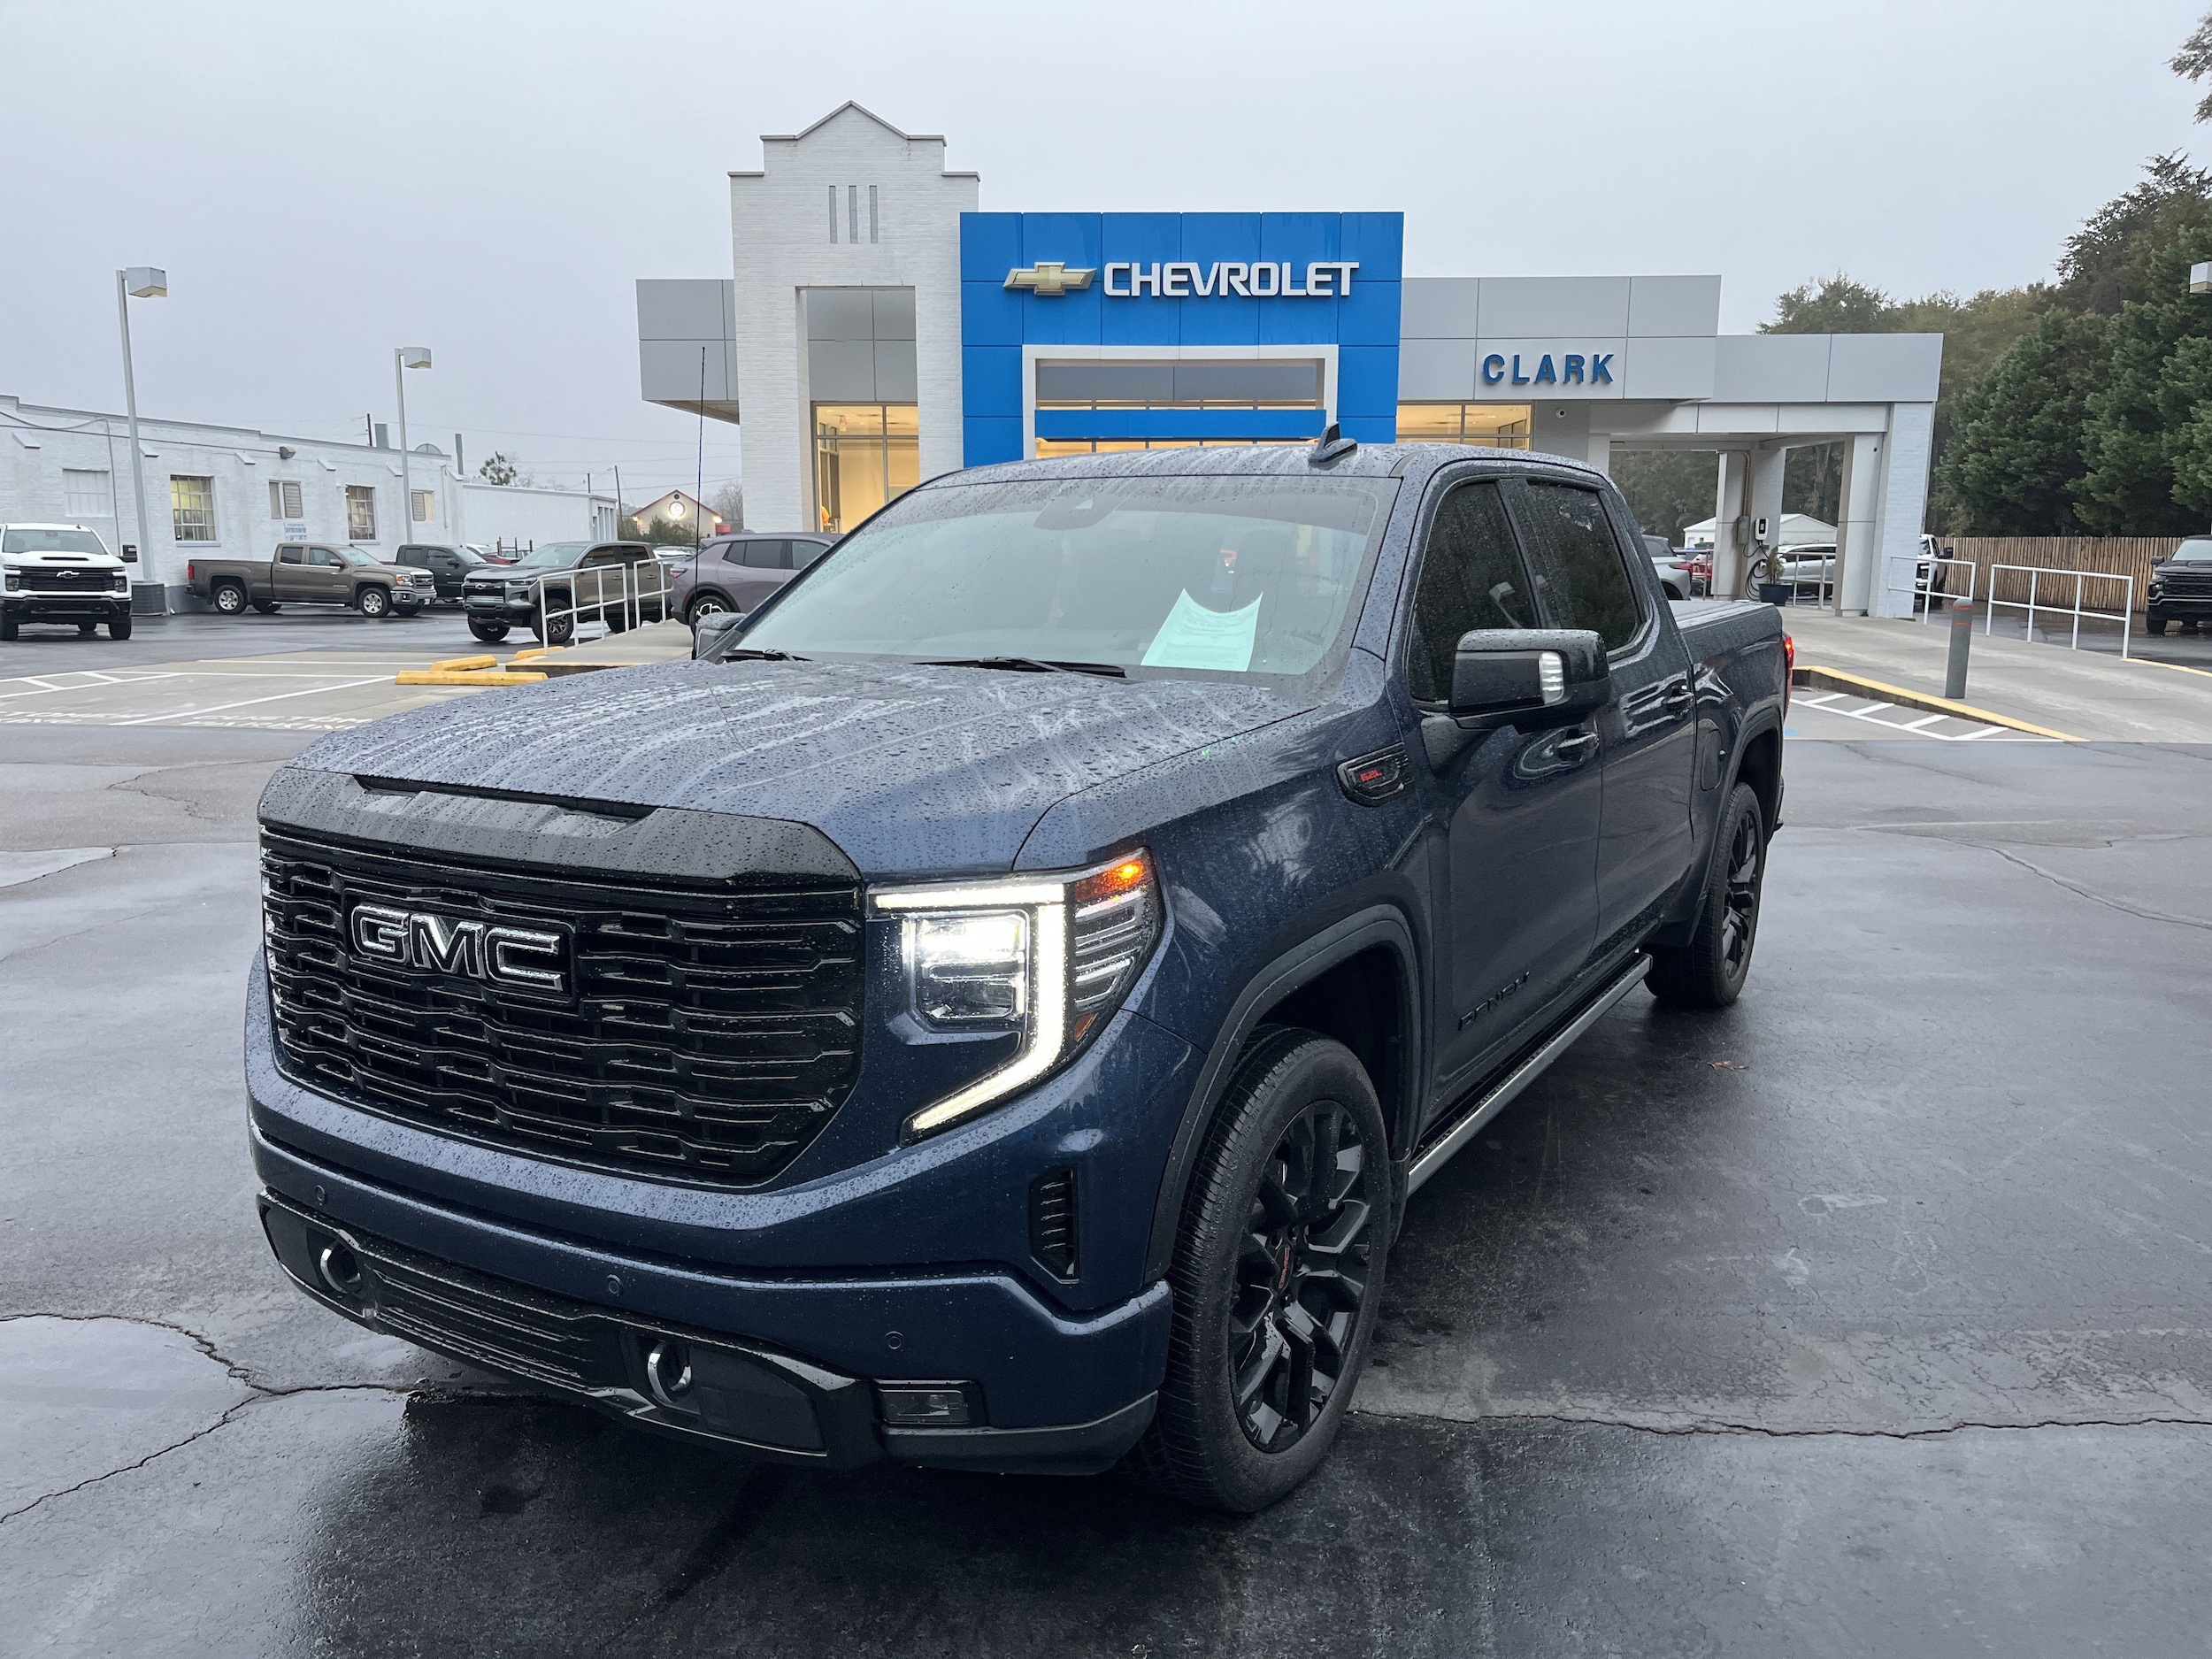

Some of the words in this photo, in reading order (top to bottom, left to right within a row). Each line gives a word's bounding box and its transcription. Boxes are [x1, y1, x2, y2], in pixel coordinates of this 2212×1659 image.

[1104, 262, 1360, 296] CHEVROLET
[1483, 354, 1615, 383] CLARK
[351, 902, 564, 992] GMC
[1278, 1247, 1290, 1289] GMC
